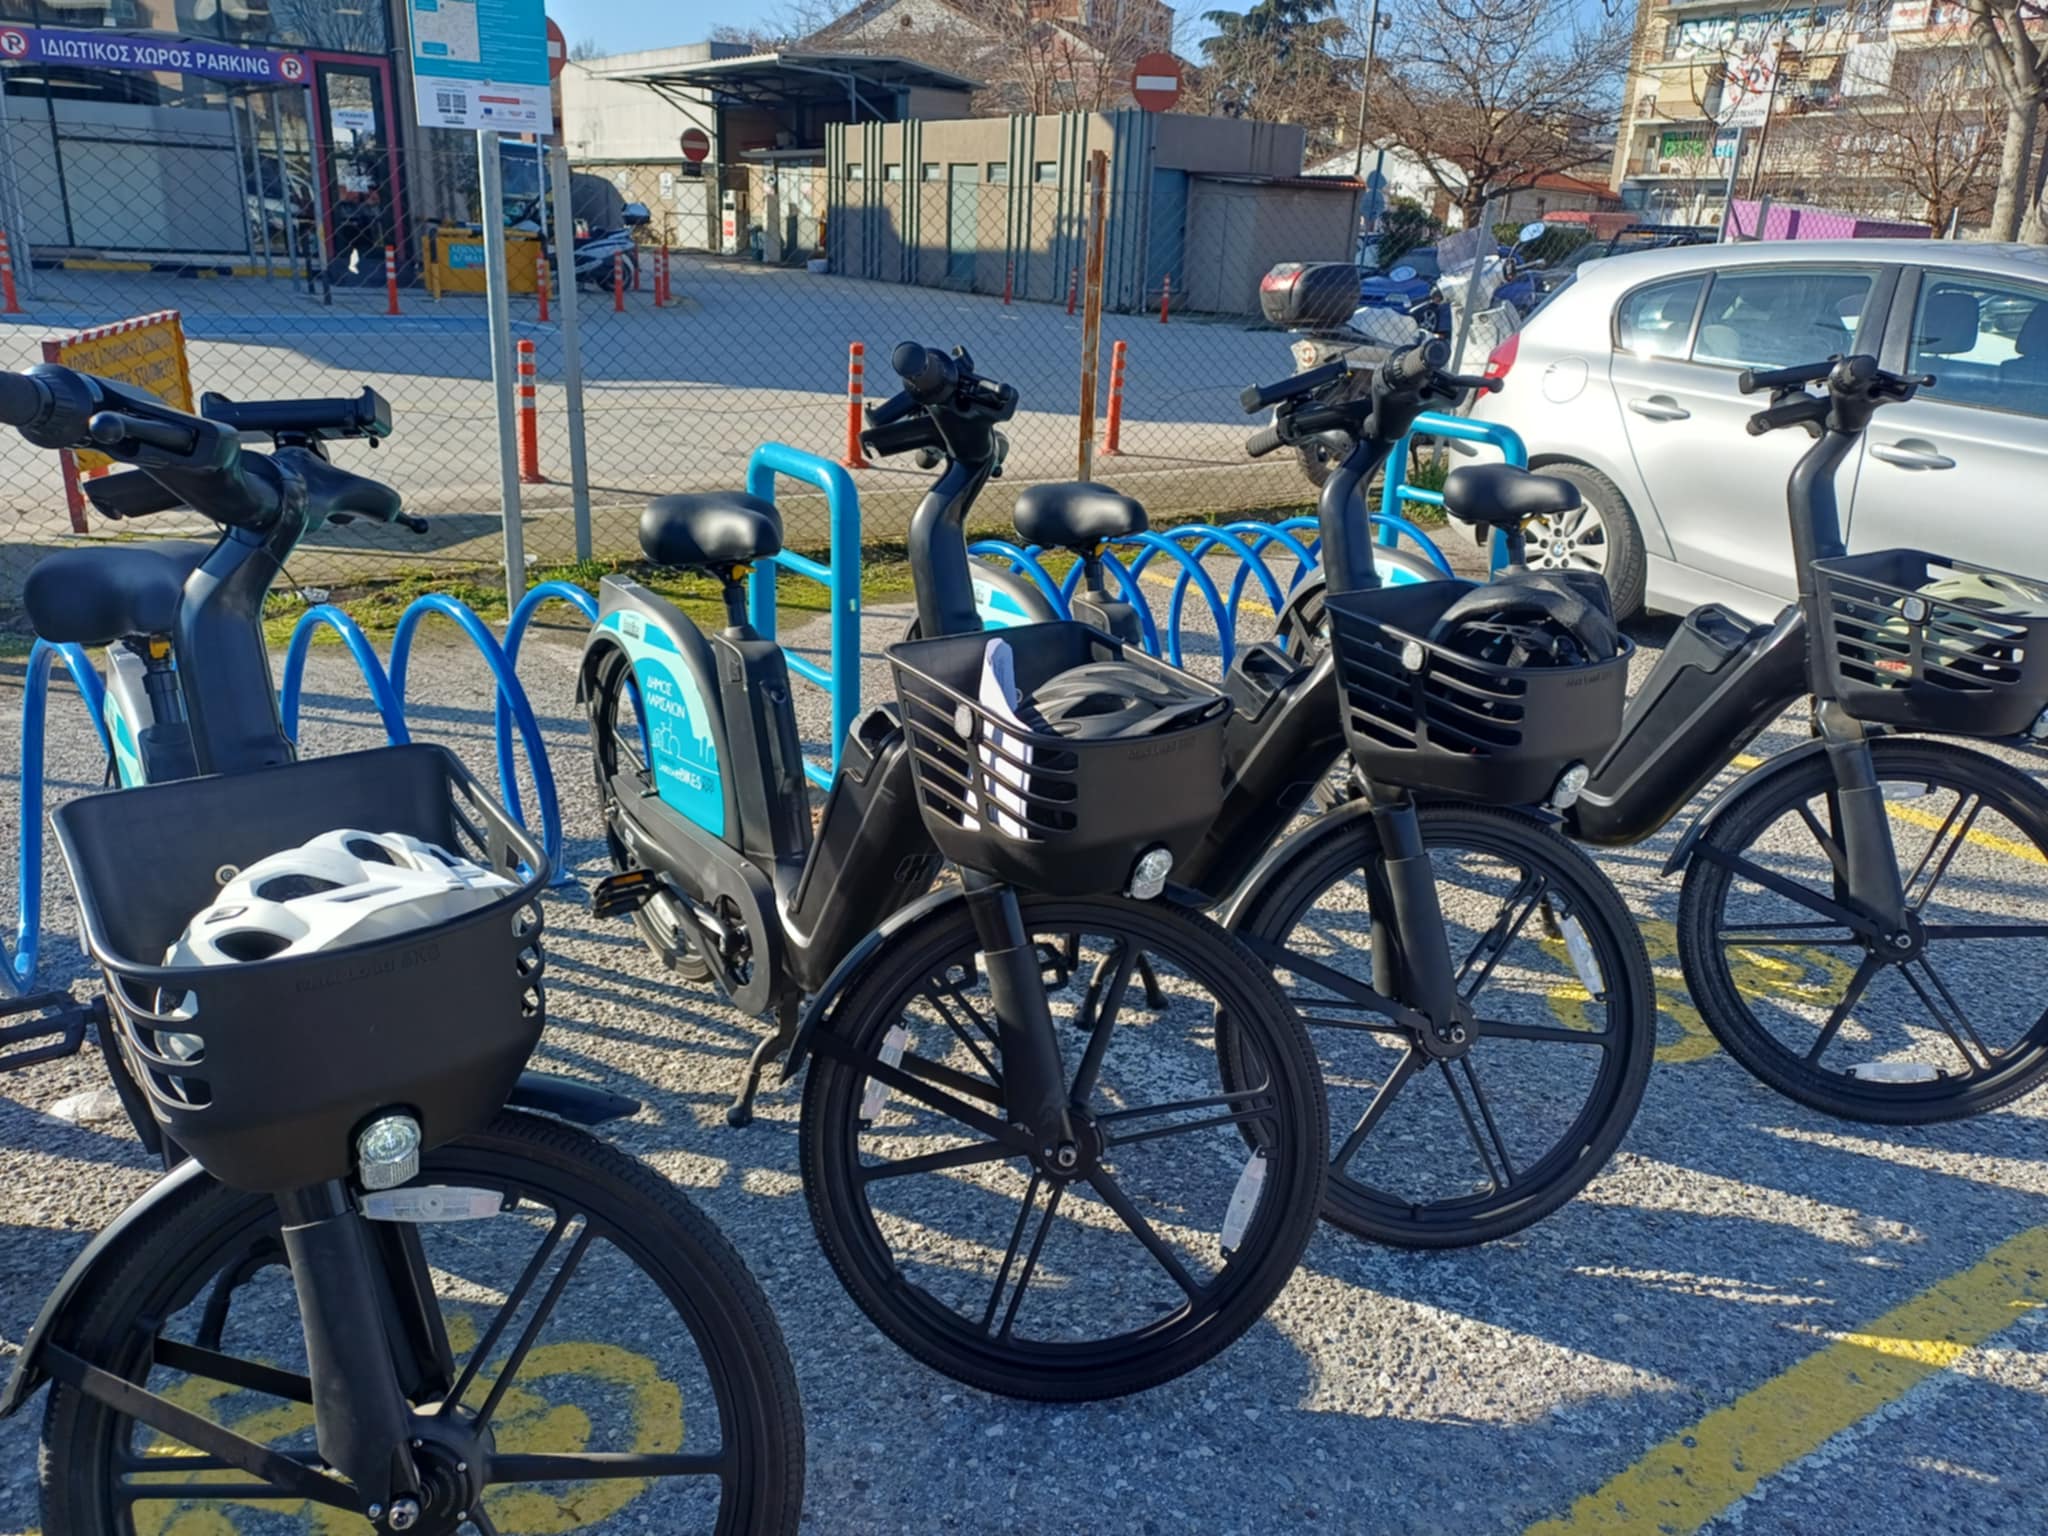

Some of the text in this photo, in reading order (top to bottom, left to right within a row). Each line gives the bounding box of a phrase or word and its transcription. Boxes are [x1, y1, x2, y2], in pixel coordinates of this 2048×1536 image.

[41, 38, 270, 75] ΙΔΙΩΤΙΚΟΣ ΧΩΡΟΣ PARKING
